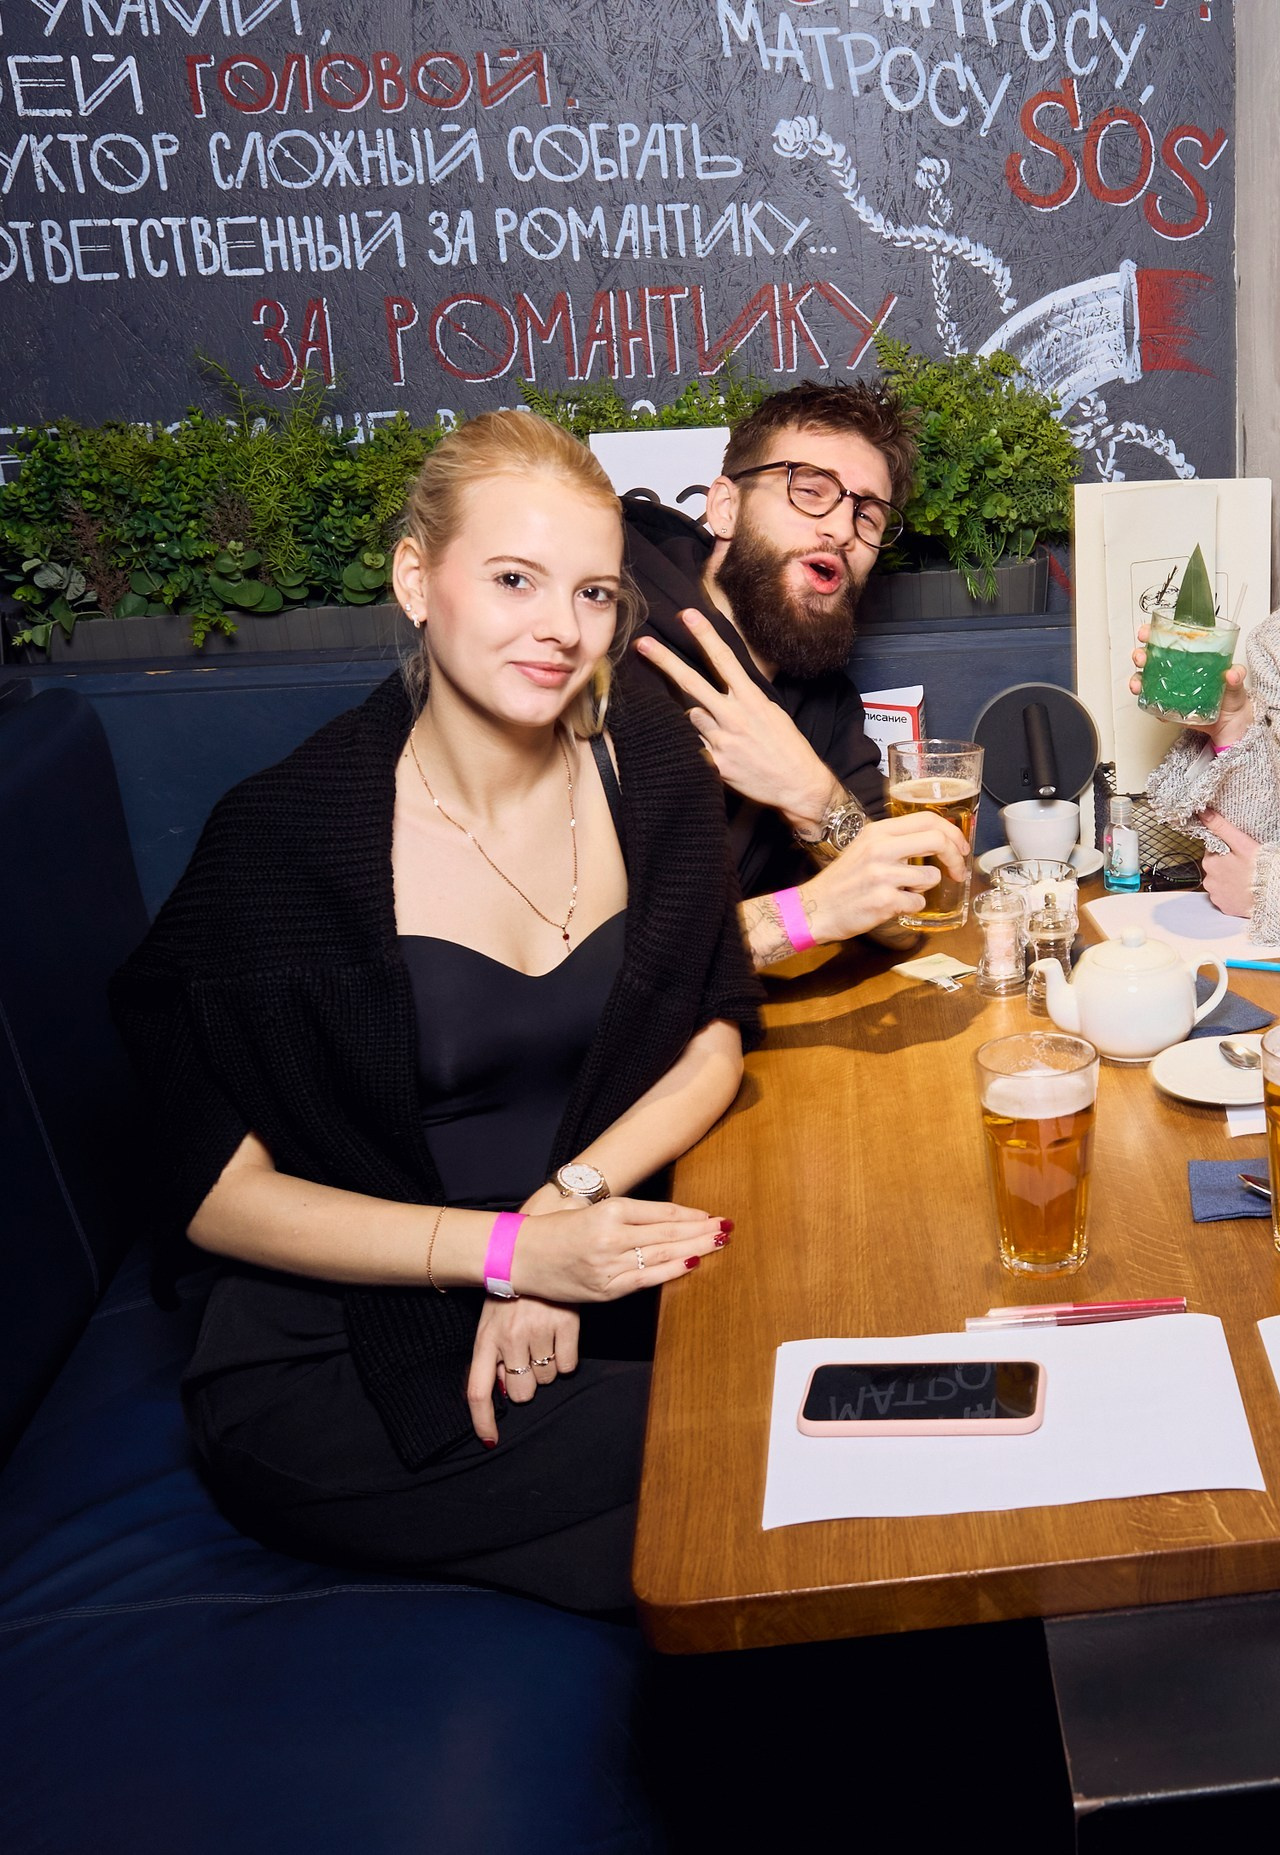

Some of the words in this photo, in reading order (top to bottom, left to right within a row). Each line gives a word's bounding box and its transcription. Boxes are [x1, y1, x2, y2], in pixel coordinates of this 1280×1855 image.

[0, 54, 143, 117] ЕЙ
[717, 0, 1012, 137] МАТРОСУ
[209, 124, 484, 190] СЛОЖНЫЙ
[507, 122, 744, 183] СОБРАТЬ
[1005, 78, 1229, 241] SOS
[428, 210, 478, 266] ЗА
[495, 201, 837, 262] РОМАНТИКУ...
[252, 297, 336, 391] ЗА
[384, 281, 898, 387] РОМАНТИКУ
